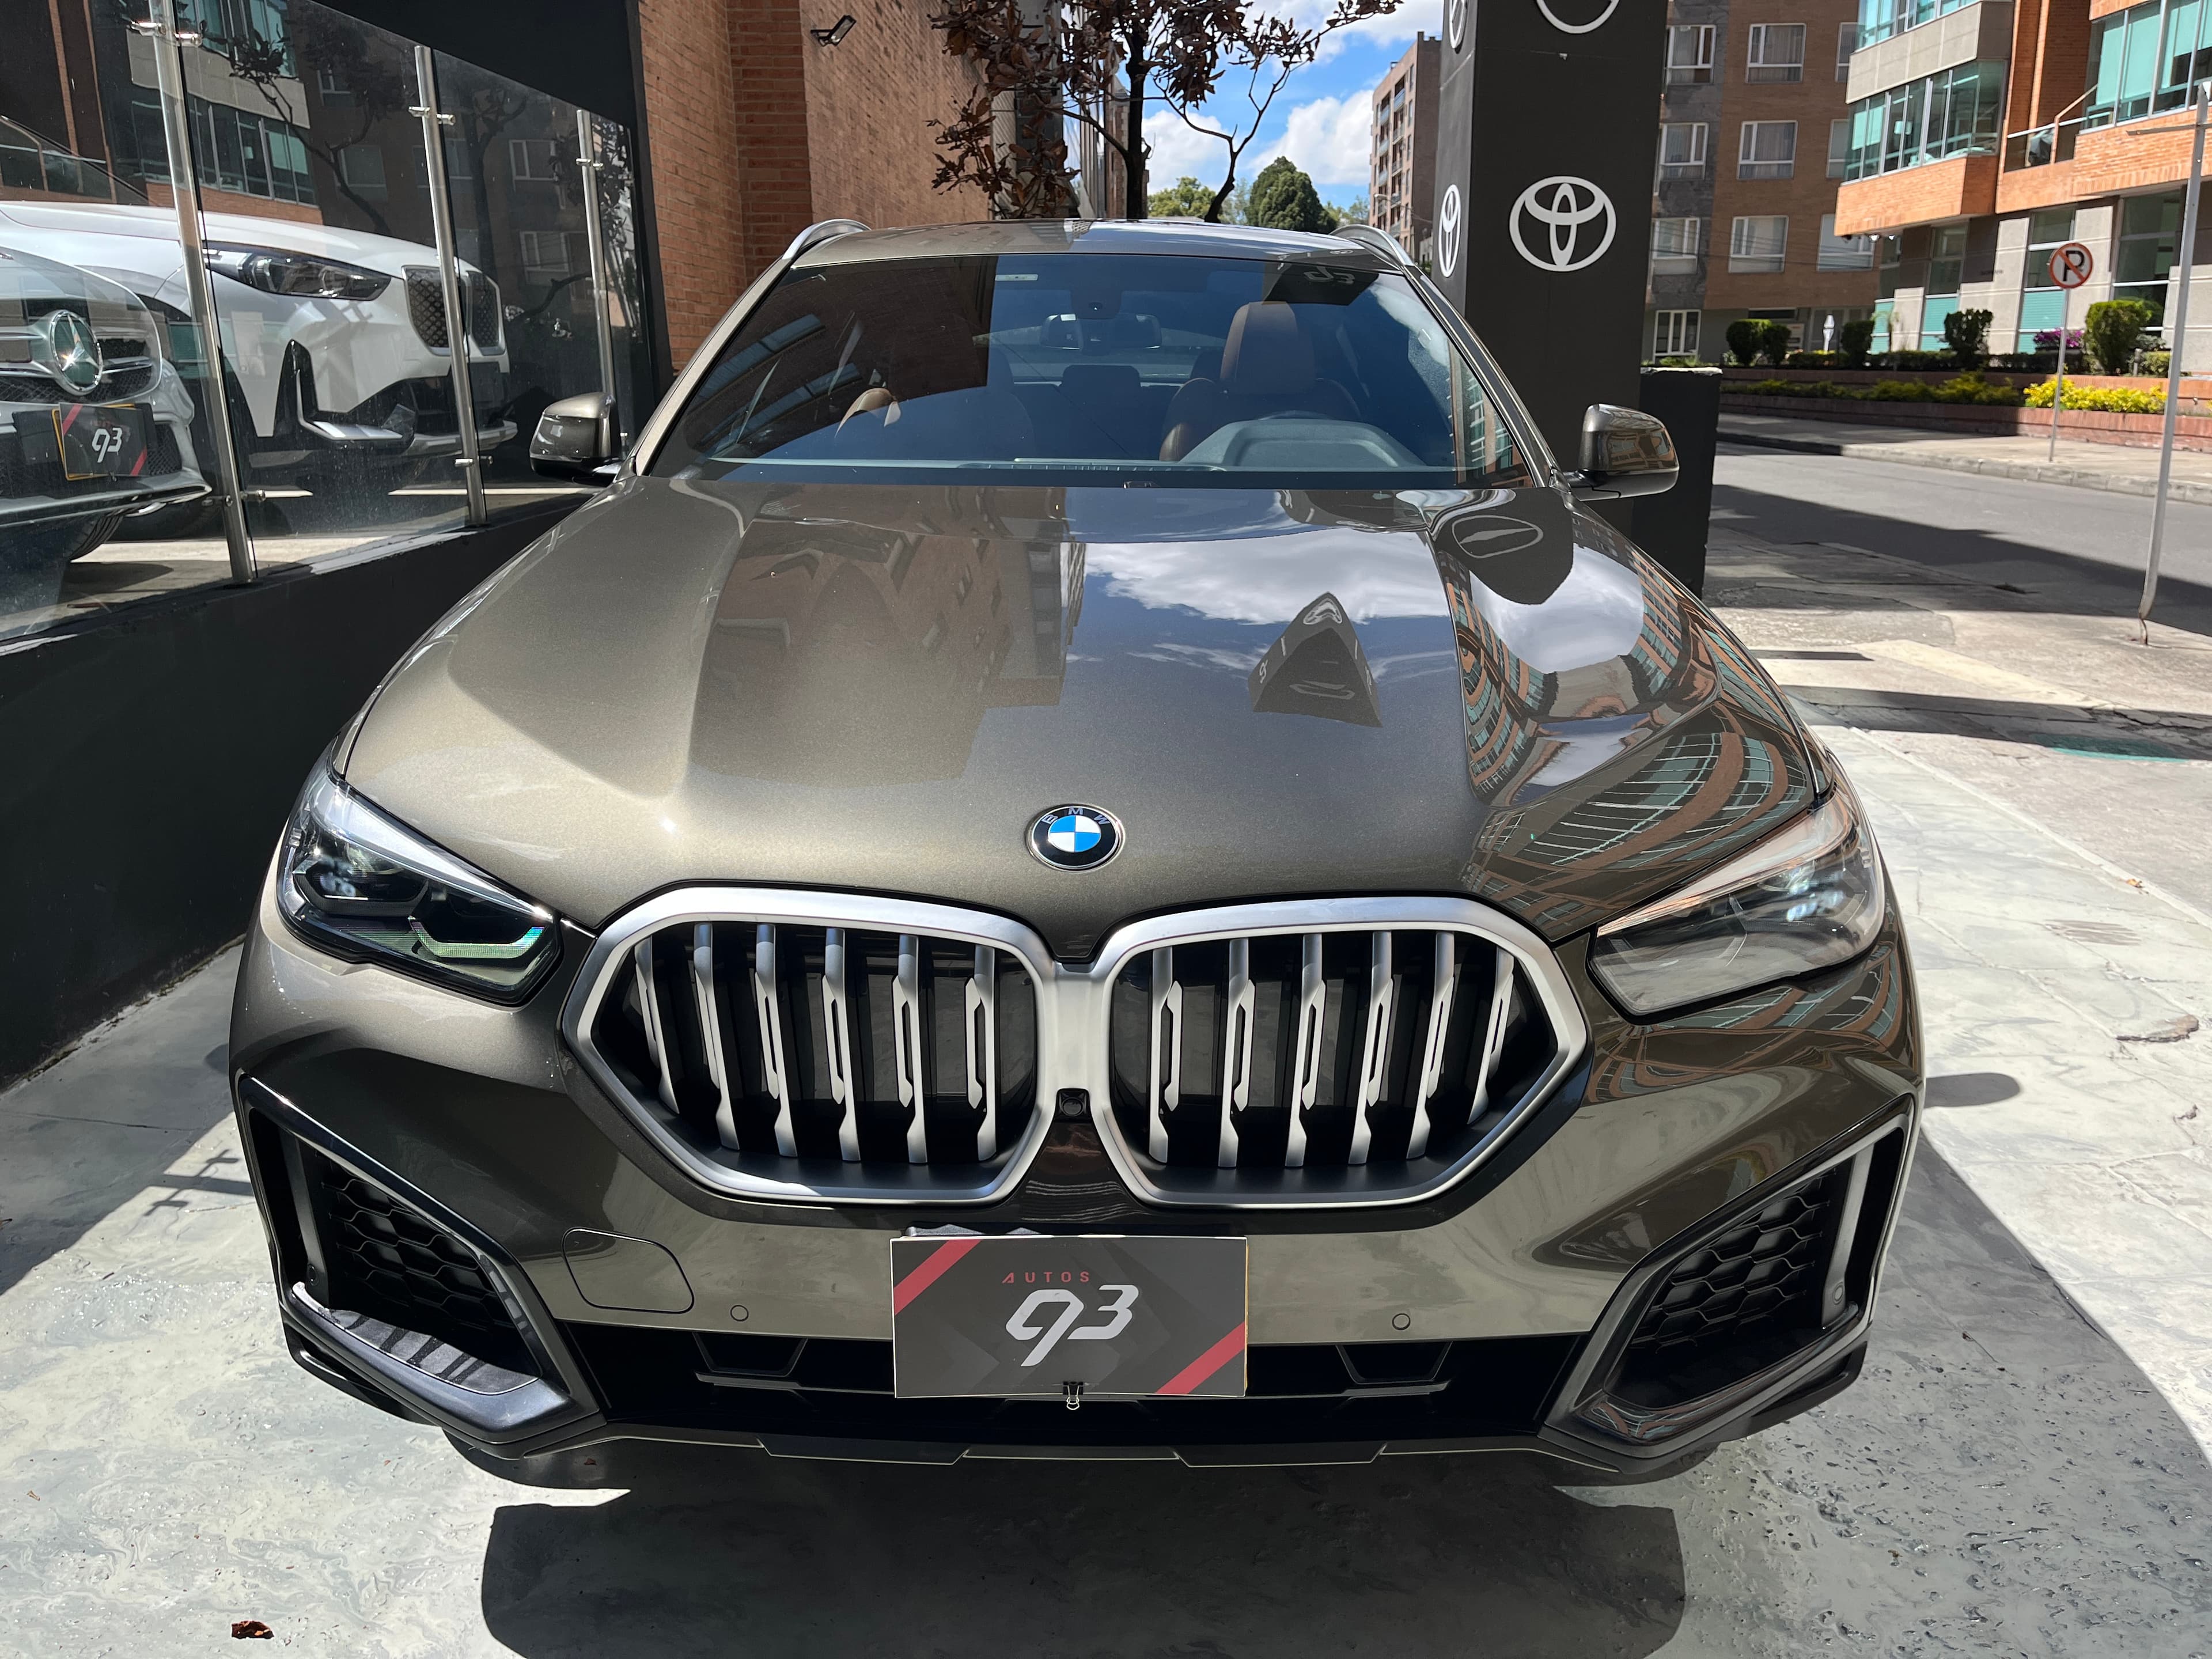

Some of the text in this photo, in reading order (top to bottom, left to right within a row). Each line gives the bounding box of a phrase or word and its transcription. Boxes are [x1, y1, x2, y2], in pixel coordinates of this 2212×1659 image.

[2063, 251, 2084, 281] P
[92, 427, 122, 463] 93
[1041, 808, 1110, 825] BMW
[1001, 1271, 1090, 1284] AUTOS
[1006, 1285, 1139, 1367] 93
